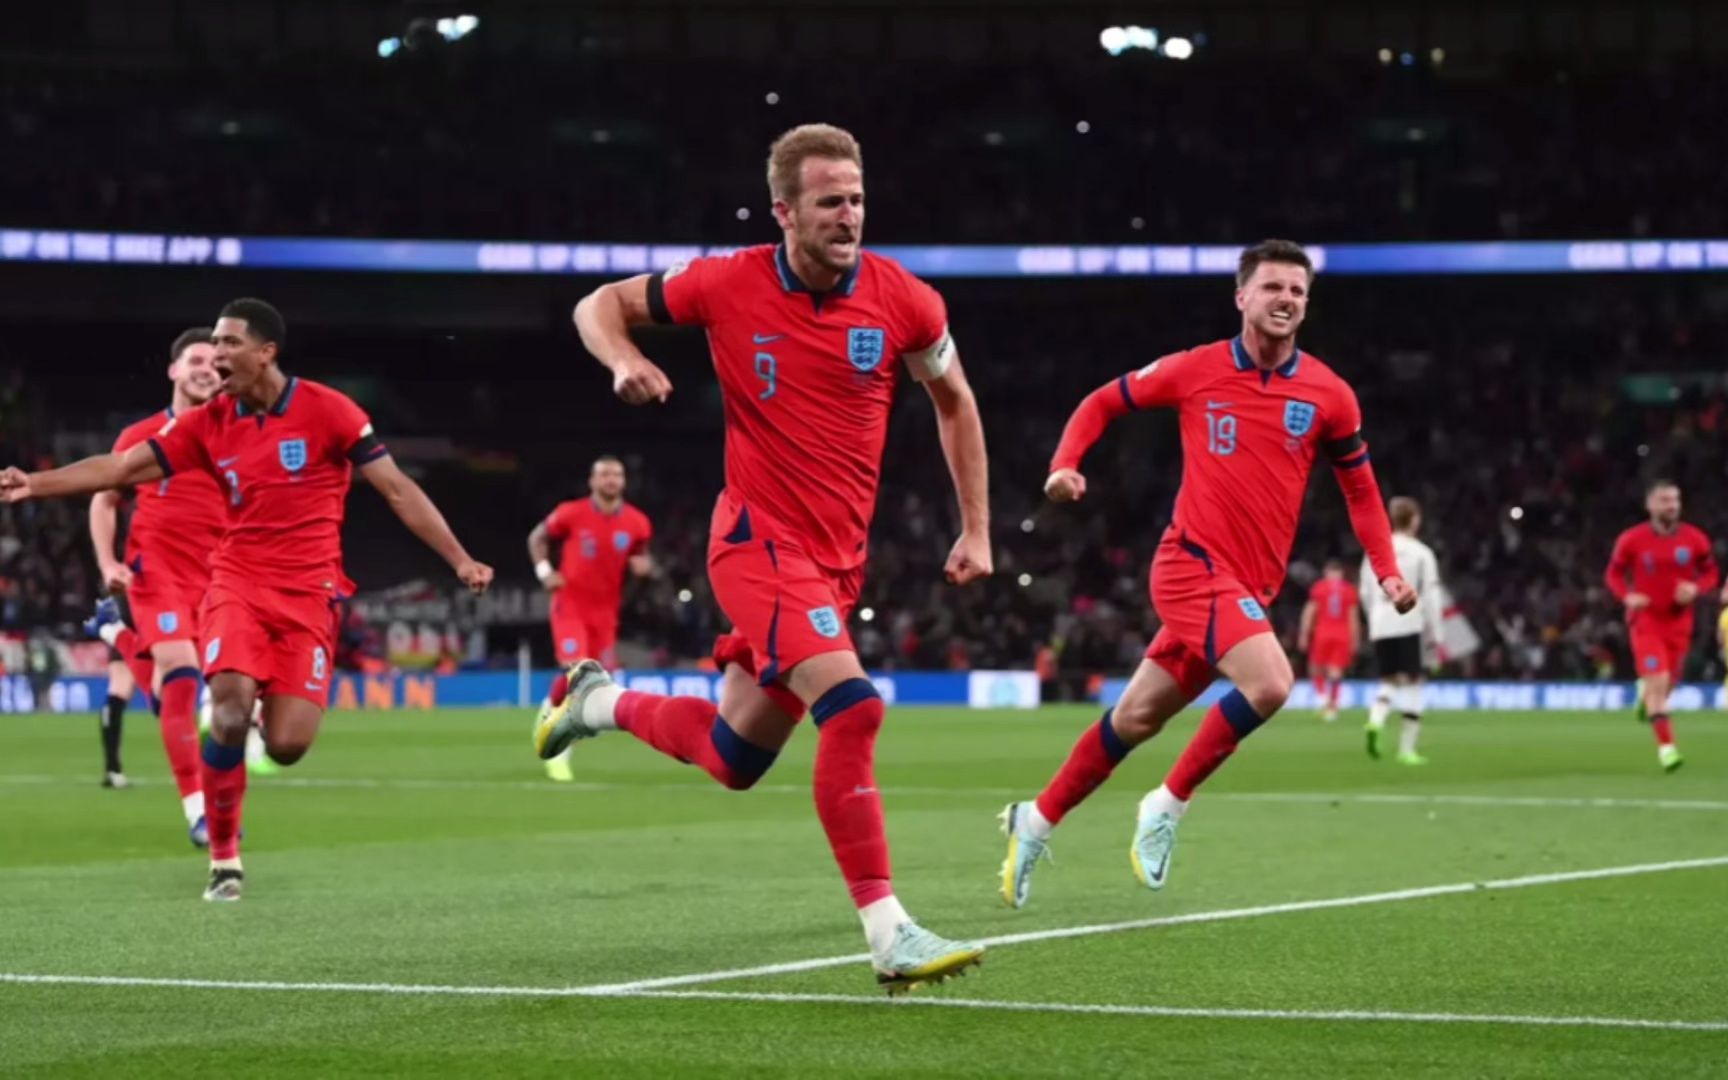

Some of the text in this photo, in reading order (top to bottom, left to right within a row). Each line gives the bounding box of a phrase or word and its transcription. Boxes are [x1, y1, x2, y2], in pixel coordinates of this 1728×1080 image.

[755, 351, 776, 400] 9
[1206, 411, 1237, 455] 19
[313, 646, 327, 680] 8
